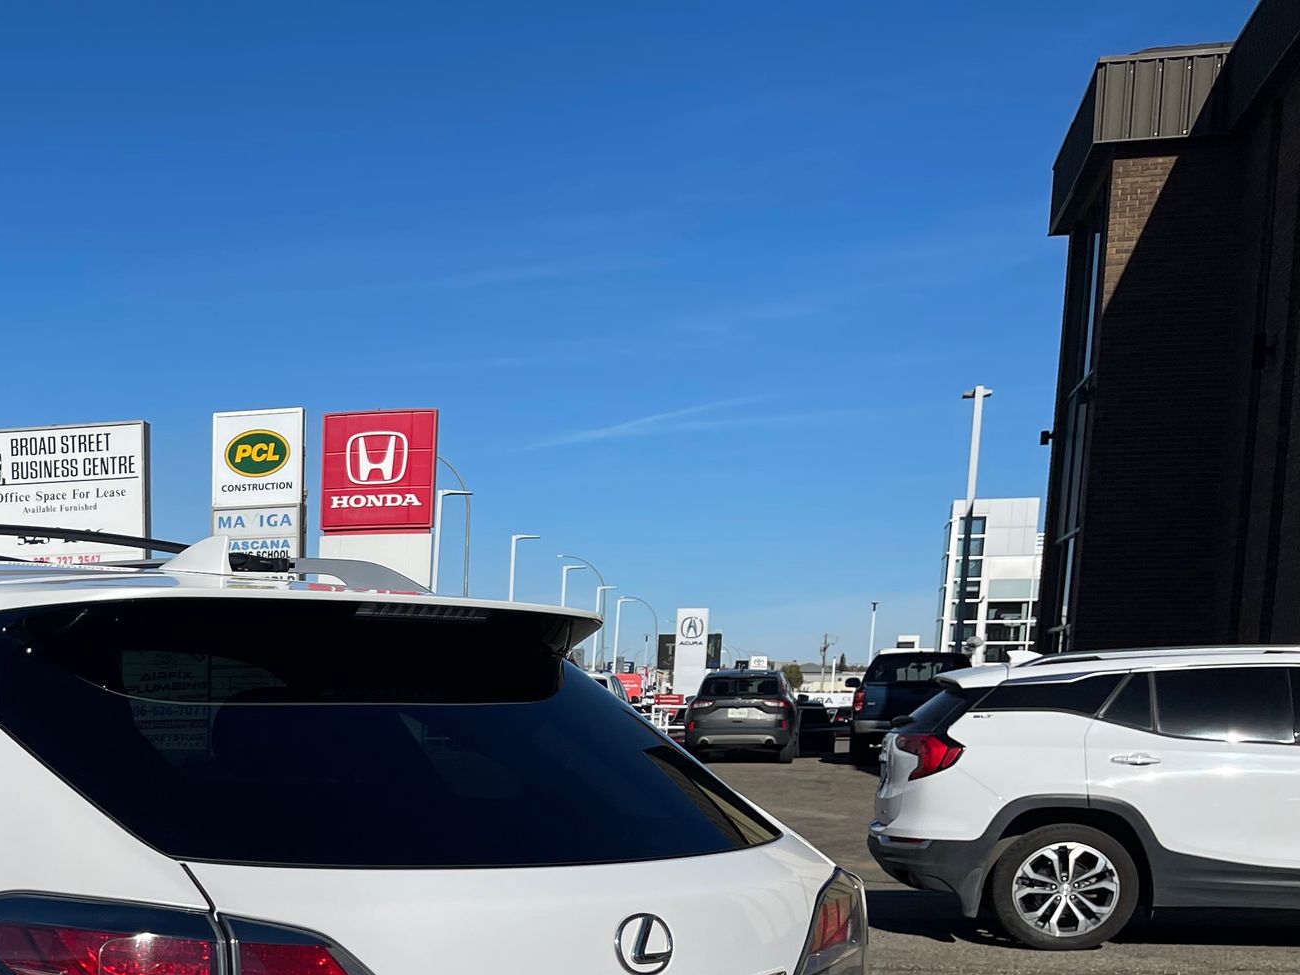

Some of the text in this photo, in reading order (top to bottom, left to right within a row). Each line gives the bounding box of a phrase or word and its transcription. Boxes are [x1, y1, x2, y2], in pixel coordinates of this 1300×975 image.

[10, 433, 111, 457] BROAD STREET
[235, 442, 280, 463] PCL
[11, 455, 135, 480] BUSINESS CENTRE
[35, 490, 67, 503] Space
[72, 488, 90, 500] For
[96, 487, 126, 499] Lease
[221, 481, 293, 493] CONSTRUCTION
[22, 503, 98, 514] Available Furnished
[330, 493, 421, 509] HONDA
[229, 539, 291, 551] ASCANA
